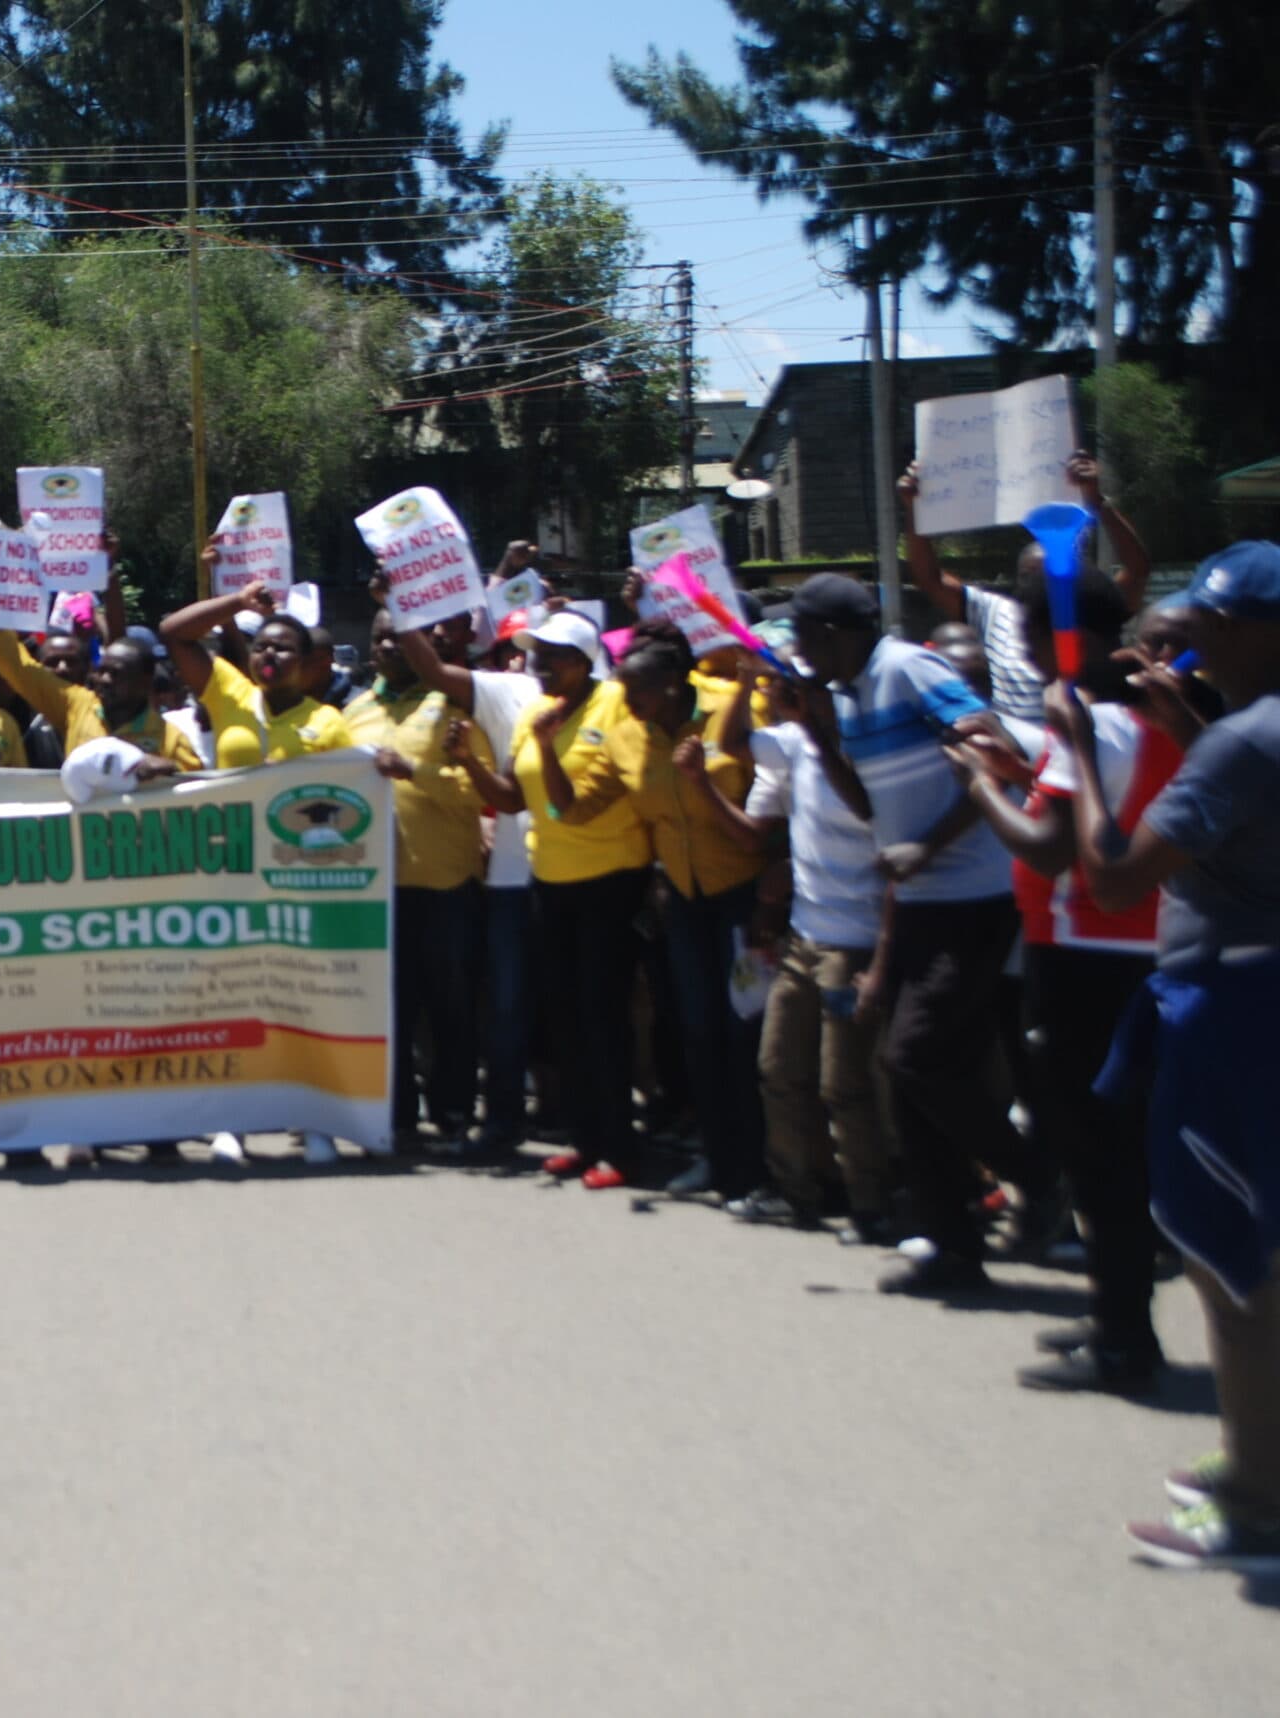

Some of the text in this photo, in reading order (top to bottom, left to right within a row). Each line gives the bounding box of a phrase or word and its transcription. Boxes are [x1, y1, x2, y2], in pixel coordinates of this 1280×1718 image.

[7, 541, 26, 559] NO
[409, 529, 433, 551] NO
[435, 521, 456, 539] TO
[41, 560, 89, 576] AHEAD
[387, 546, 463, 585] MEDICAL
[397, 574, 469, 612] SCHEME
[80, 801, 254, 881] BRANCH
[41, 904, 313, 950] SCHOOL!!!
[94, 1025, 229, 1054] allowance
[45, 1060, 106, 1089] ON
[110, 1050, 242, 1086] STRIKE
